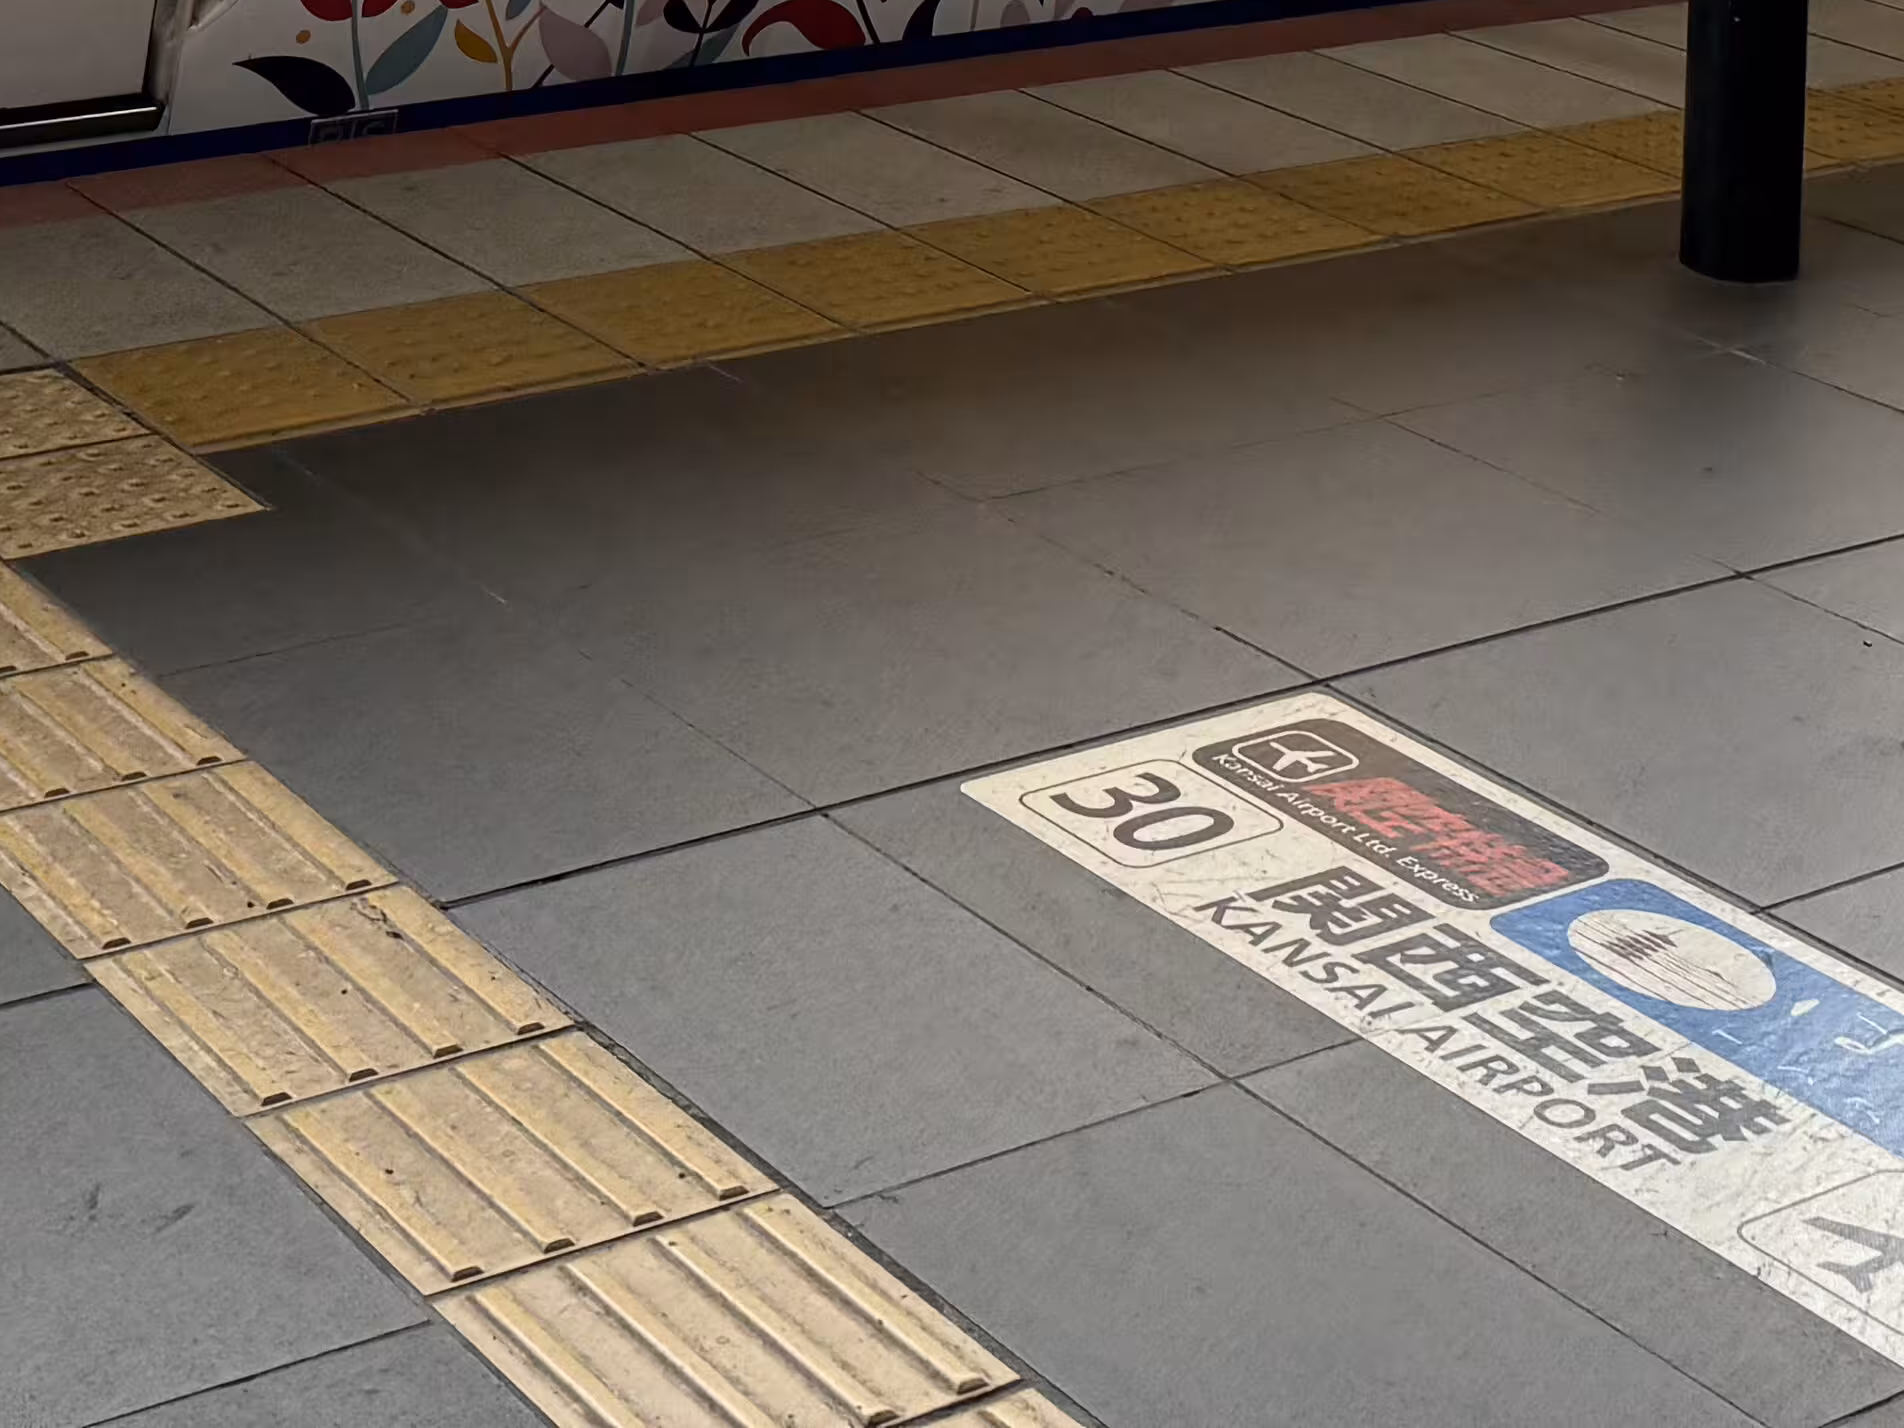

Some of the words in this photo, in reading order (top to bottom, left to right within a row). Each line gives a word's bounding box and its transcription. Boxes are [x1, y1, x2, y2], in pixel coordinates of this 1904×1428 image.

[1051, 772, 1235, 851] 30
[1212, 753, 1284, 793] Kansai
[1280, 789, 1356, 836] Airport
[1353, 831, 1393, 859] Ltd.
[1395, 855, 1480, 904] Express
[1196, 897, 1418, 1019] KANSAI
[1400, 1024, 1682, 1172] AIRPORT
[1247, 865, 1790, 1156] 関西空港
